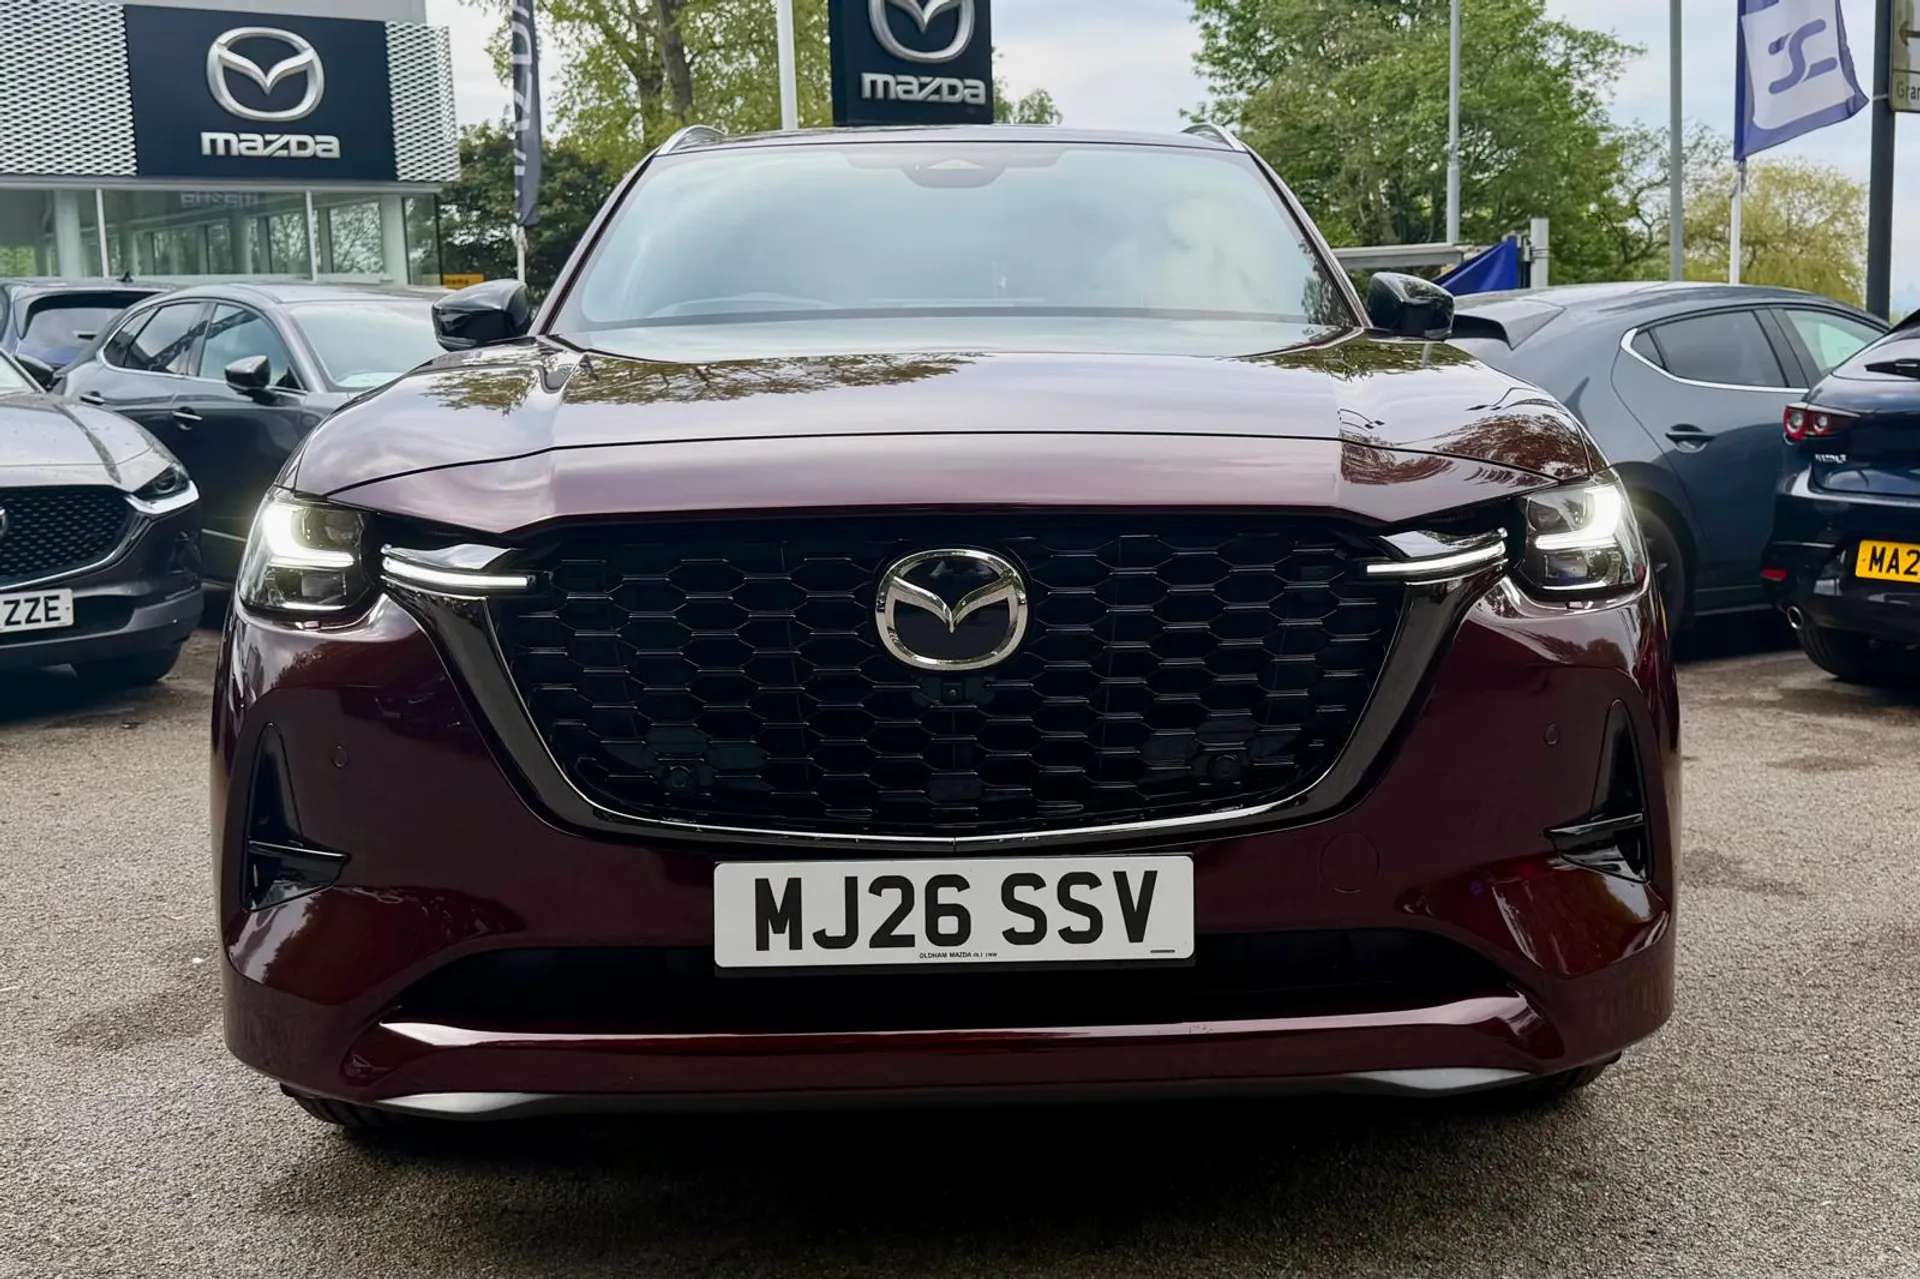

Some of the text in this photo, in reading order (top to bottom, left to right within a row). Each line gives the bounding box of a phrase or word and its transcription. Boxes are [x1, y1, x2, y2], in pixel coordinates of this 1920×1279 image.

[1869, 545, 1920, 576] MA2
[4, 595, 61, 626] ZZE
[755, 870, 1158, 951] MJ26 SSV
